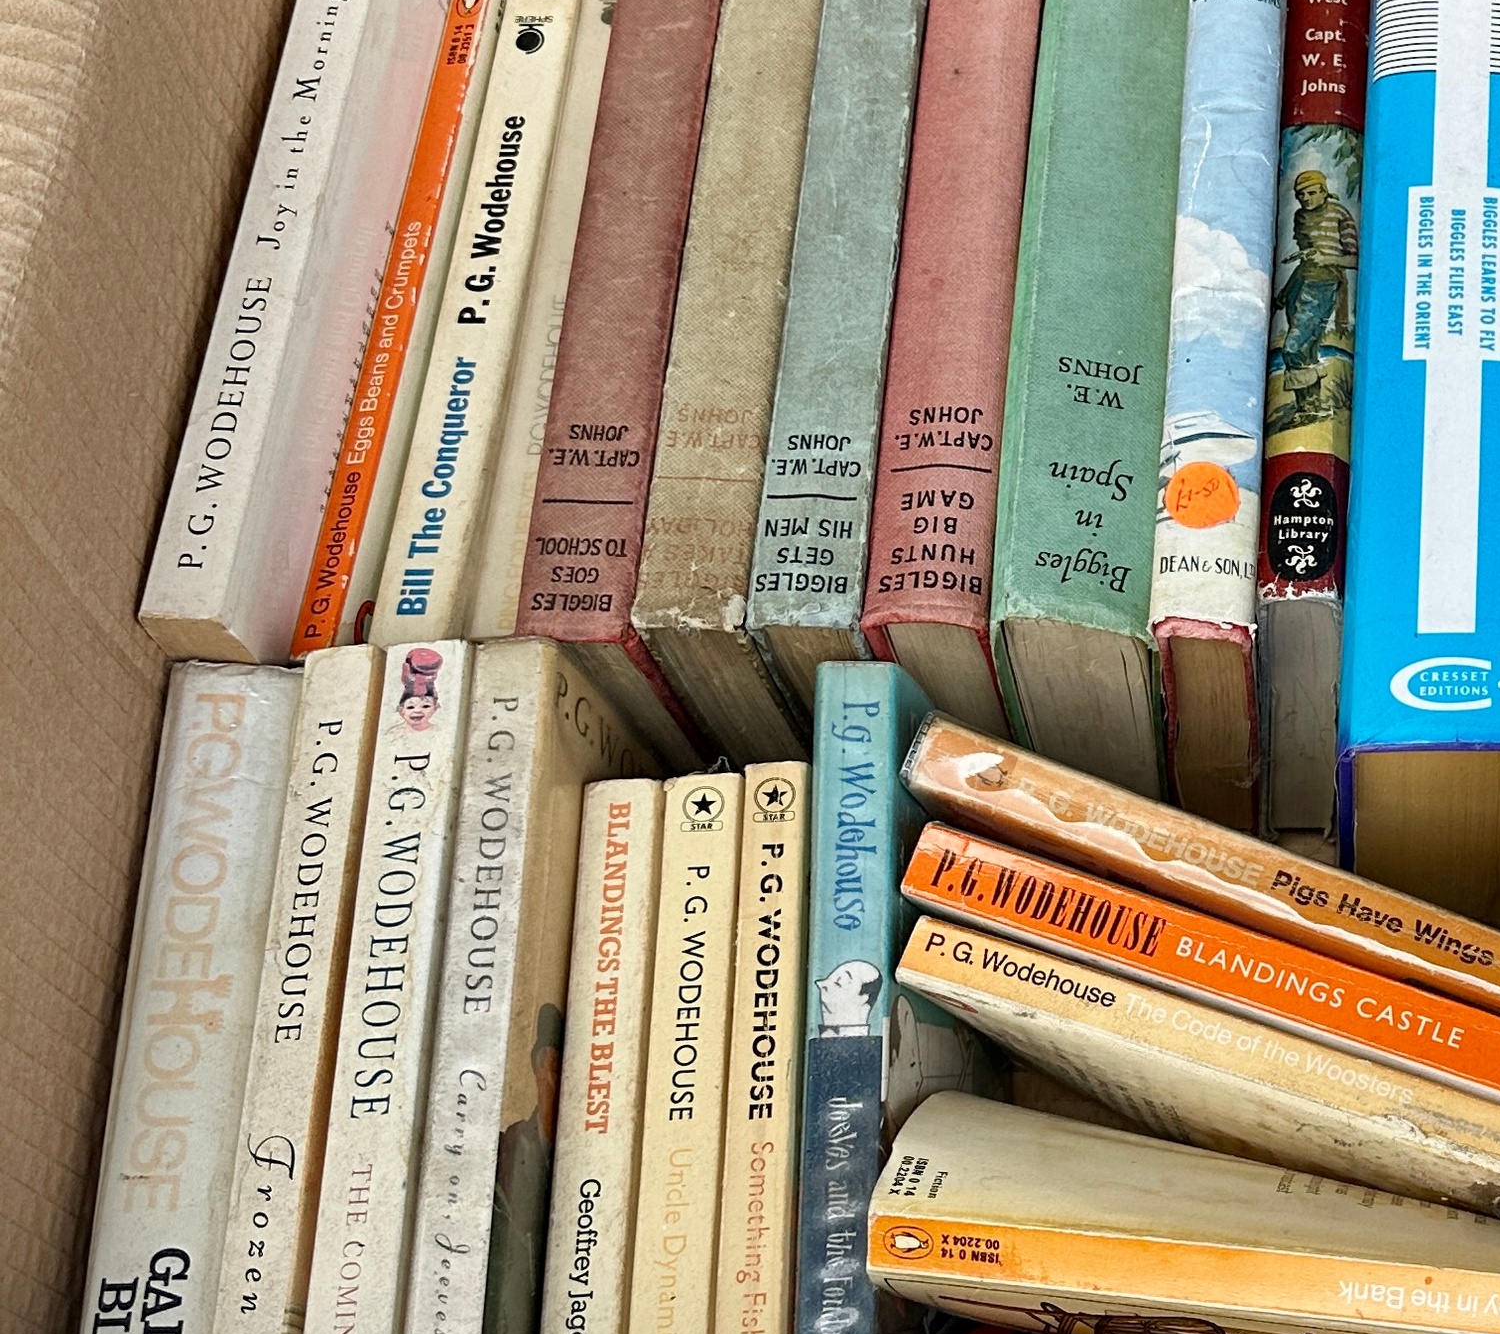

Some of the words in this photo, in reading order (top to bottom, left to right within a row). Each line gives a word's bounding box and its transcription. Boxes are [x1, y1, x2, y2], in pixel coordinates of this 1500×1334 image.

[1301, 79, 1346, 95] Johns
[1418, 196, 1434, 249] BIGGLES
[1450, 209, 1466, 262] BIGGLES
[1482, 197, 1498, 249] BIGGLES
[1416, 273, 1432, 296] THE
[1449, 267, 1464, 299] FLIES
[1481, 254, 1496, 303] LEARNS
[1414, 302, 1431, 350] ORIENT
[1448, 305, 1464, 336] EAST
[1479, 330, 1495, 351] FLY
[397, 549, 428, 616] Bill
[422, 356, 476, 495] Conqueror
[475, 116, 525, 260] Wodehouse
[1059, 357, 1144, 385] JOHNS
[196, 274, 272, 497] WODEHOUSE
[909, 407, 983, 425] JOHNS
[569, 424, 628, 441] JOHNS
[788, 434, 851, 452] JOHNS
[1048, 459, 1133, 502] Spain
[901, 490, 974, 510] GAME
[765, 518, 808, 536] MEN
[819, 520, 852, 539] HIS
[914, 517, 957, 534] BIG
[1274, 515, 1333, 527] Hampton
[1279, 529, 1328, 543] Library
[536, 537, 602, 556] SCHOOL
[777, 547, 834, 565] GETS
[891, 544, 975, 565] HUNTS
[550, 567, 599, 583] GOES
[1036, 551, 1133, 593] Biggles
[1160, 556, 1199, 574] DEAN
[756, 573, 848, 594] BIGGLES
[878, 571, 982, 594] BIGGLES
[532, 593, 612, 611] BIGGLES
[1419, 672, 1489, 682] CRESSET
[1419, 686, 1489, 696] EDITIONS
[690, 822, 714, 830] STAR
[762, 813, 786, 821] STAR
[463, 772, 513, 1016] WODEHOUSE
[596, 801, 632, 972] BLANDINGS
[274, 796, 333, 1044] WODEHOUSE
[1271, 869, 1330, 907] Pigs
[1337, 891, 1403, 934] Have
[1412, 918, 1494, 968] Wings
[989, 867, 1167, 957] WODEHOUSE
[1175, 936, 1346, 1009] BLANDINGS
[1355, 996, 1466, 1050] CASTLE
[350, 832, 421, 1120] WODEHOUSE
[591, 977, 619, 1036] THE
[748, 908, 783, 1120] WODEHOUSE
[669, 930, 706, 1121] WODEHOUSE
[982, 949, 1116, 1007] Wodehouse
[1303, 1050, 1415, 1104] Woosters
[584, 1042, 615, 1134] BLEST
[443, 1068, 487, 1157] Carry
[346, 1163, 374, 1227] THE
[663, 1148, 693, 1225] Uncle
[241, 1132, 296, 1315] Frozen
[736, 1141, 774, 1285] Something
[568, 1178, 602, 1286] Geoffrey
[1337, 1279, 1405, 1309] Bank
